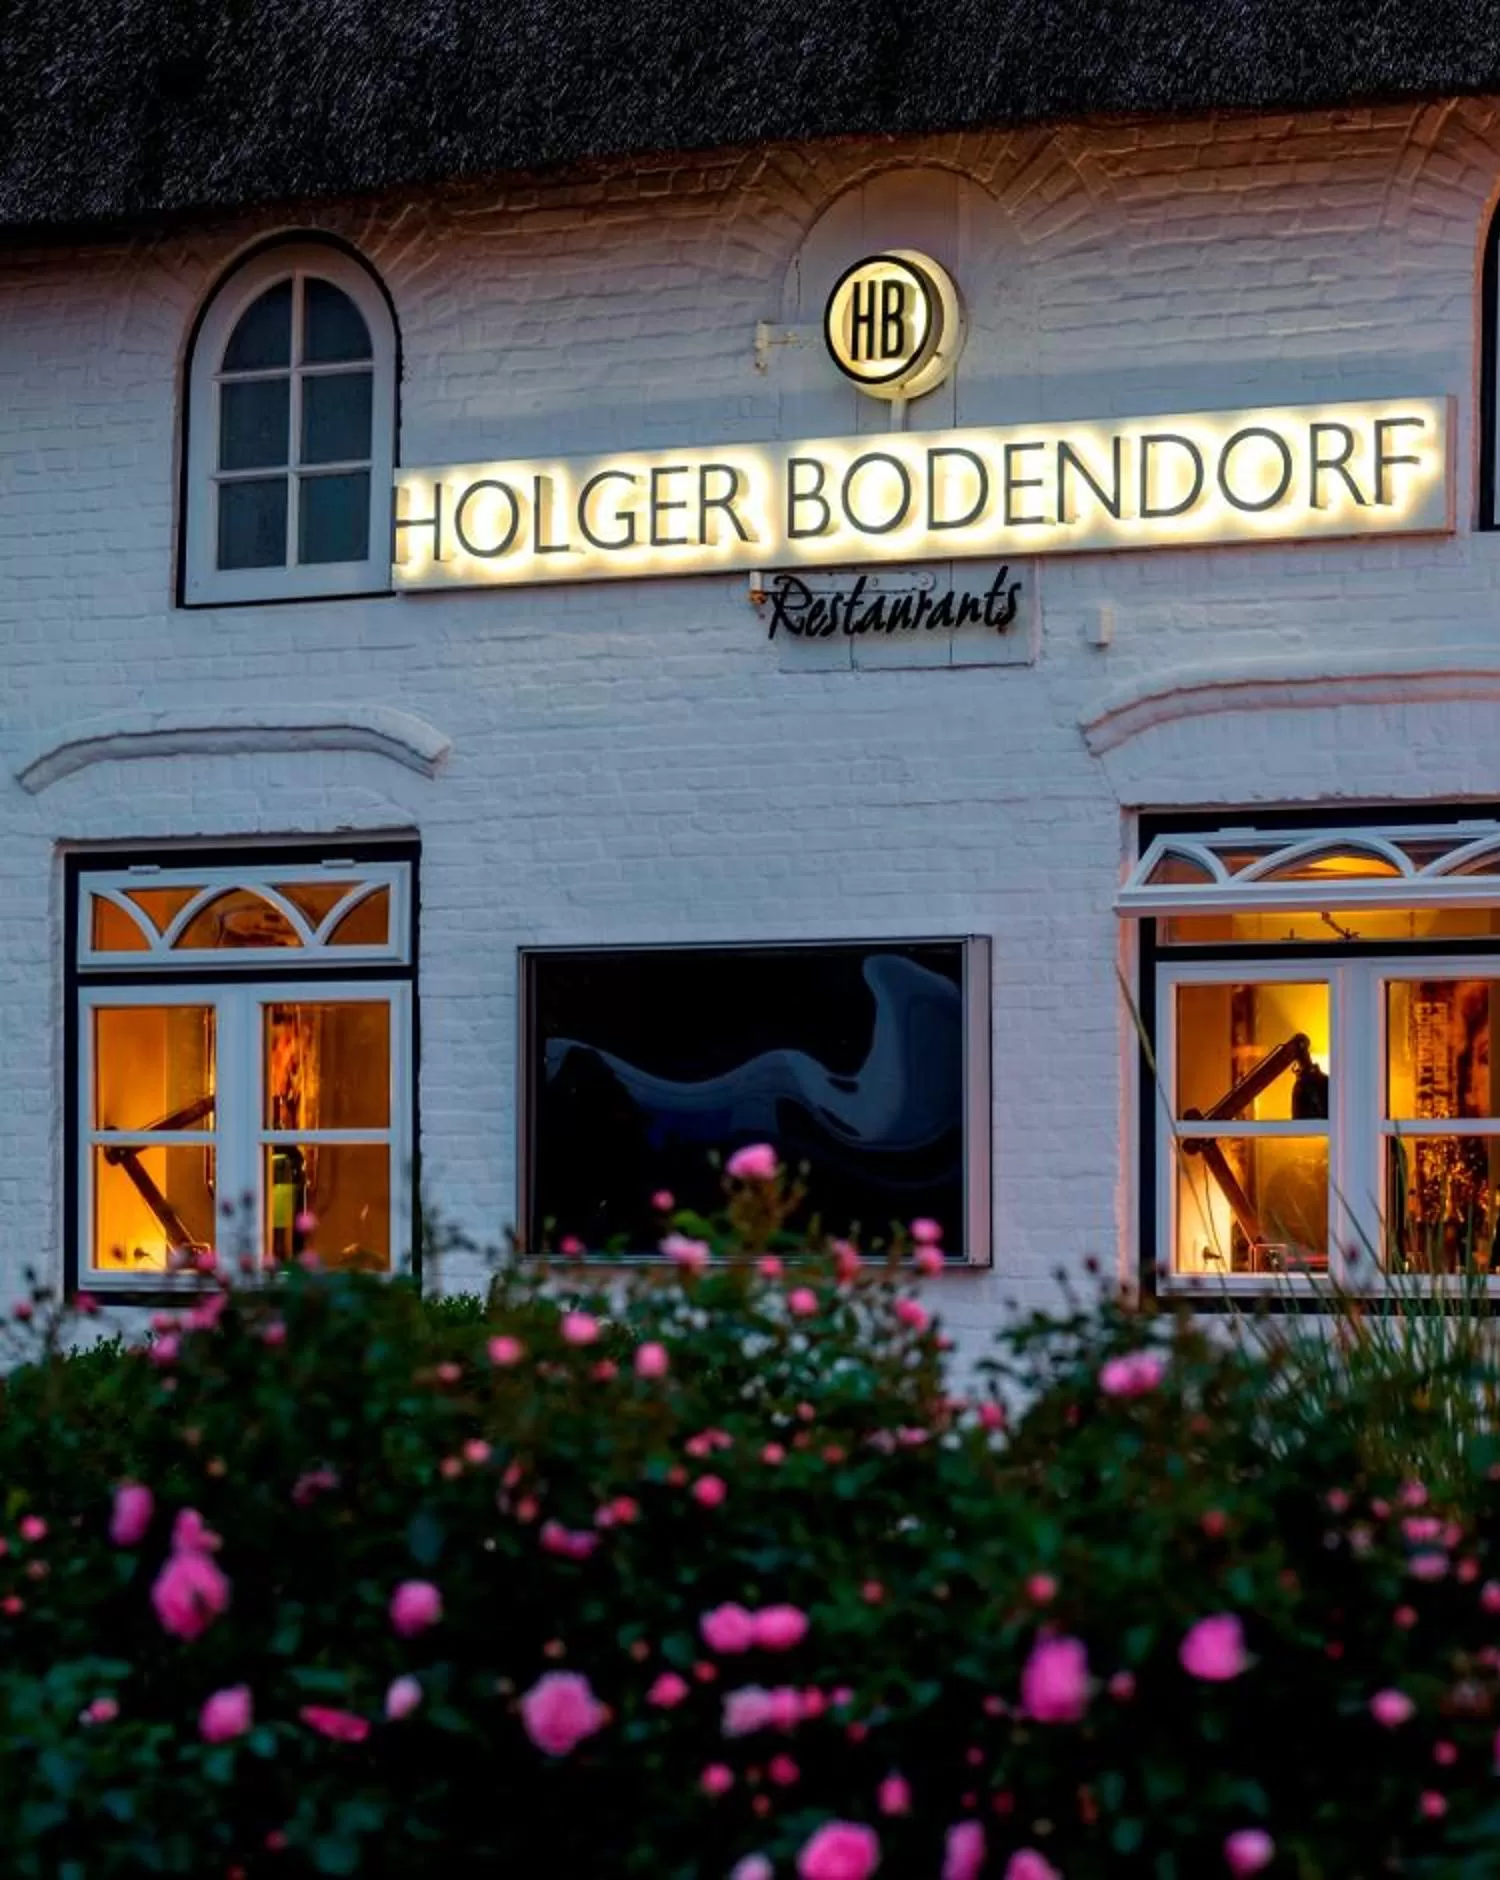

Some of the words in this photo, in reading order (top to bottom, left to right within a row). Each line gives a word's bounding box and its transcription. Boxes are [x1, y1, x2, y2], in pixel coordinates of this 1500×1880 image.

[850, 279, 904, 361] HB
[391, 463, 757, 564] HOLGER
[786, 417, 1426, 540] BODENDORF
[768, 565, 1021, 640] Restaurants
